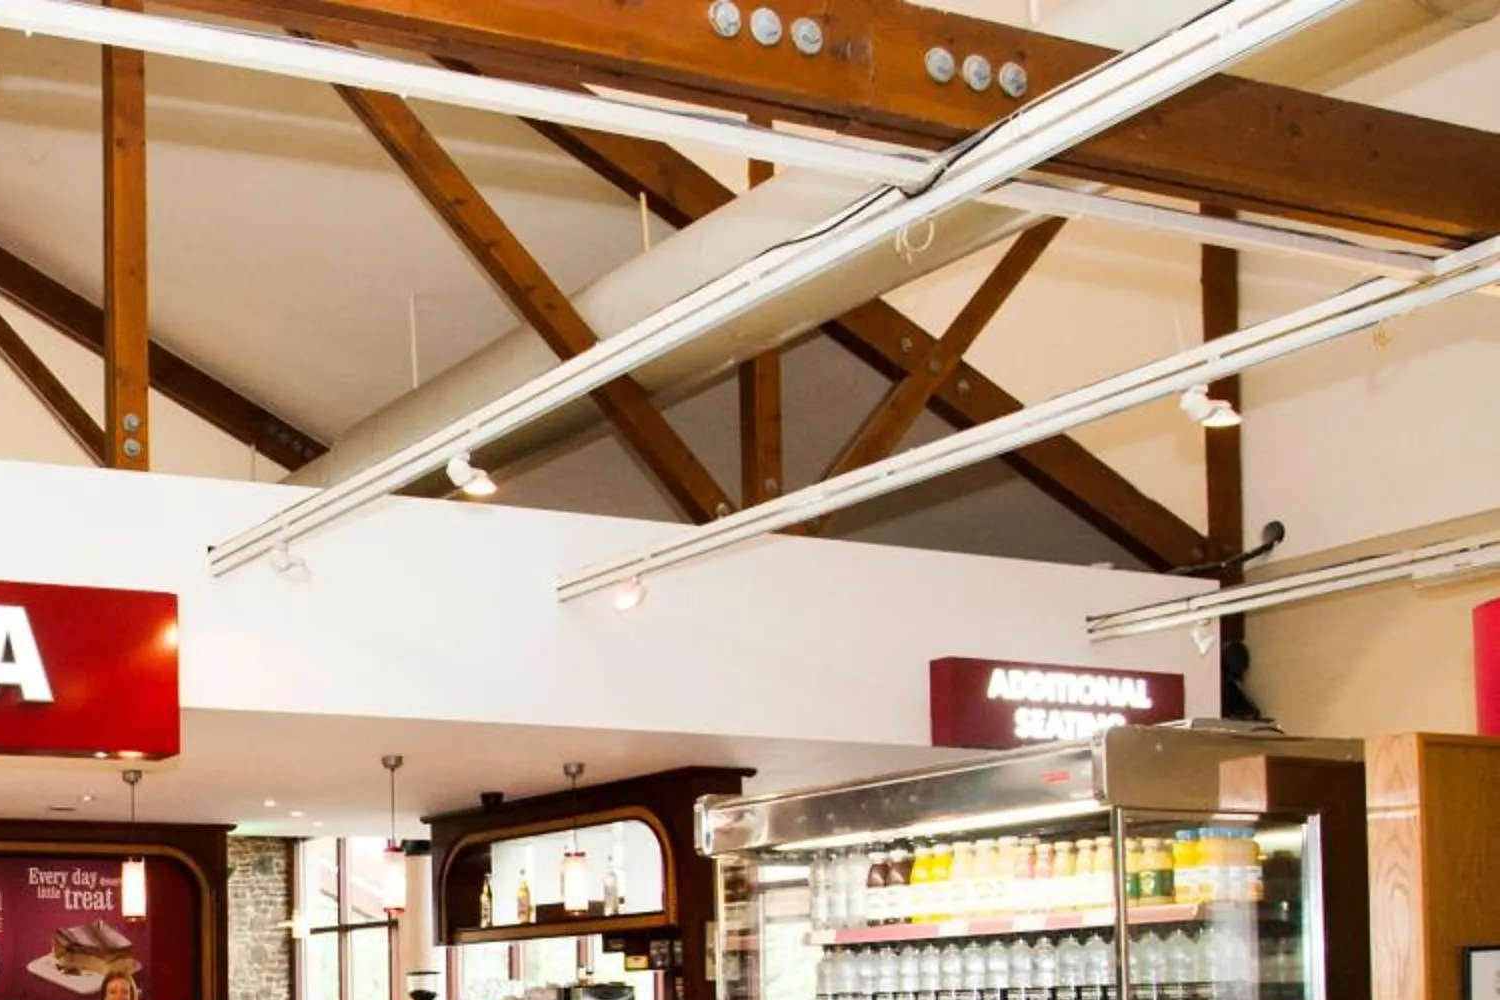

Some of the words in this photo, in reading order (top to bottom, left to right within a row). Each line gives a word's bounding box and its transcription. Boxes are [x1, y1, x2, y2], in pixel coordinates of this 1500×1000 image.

[987, 668, 1153, 708] ADDITIONAL
[28, 867, 69, 888] Every
[72, 868, 99, 889] day
[64, 887, 115, 911] treat
